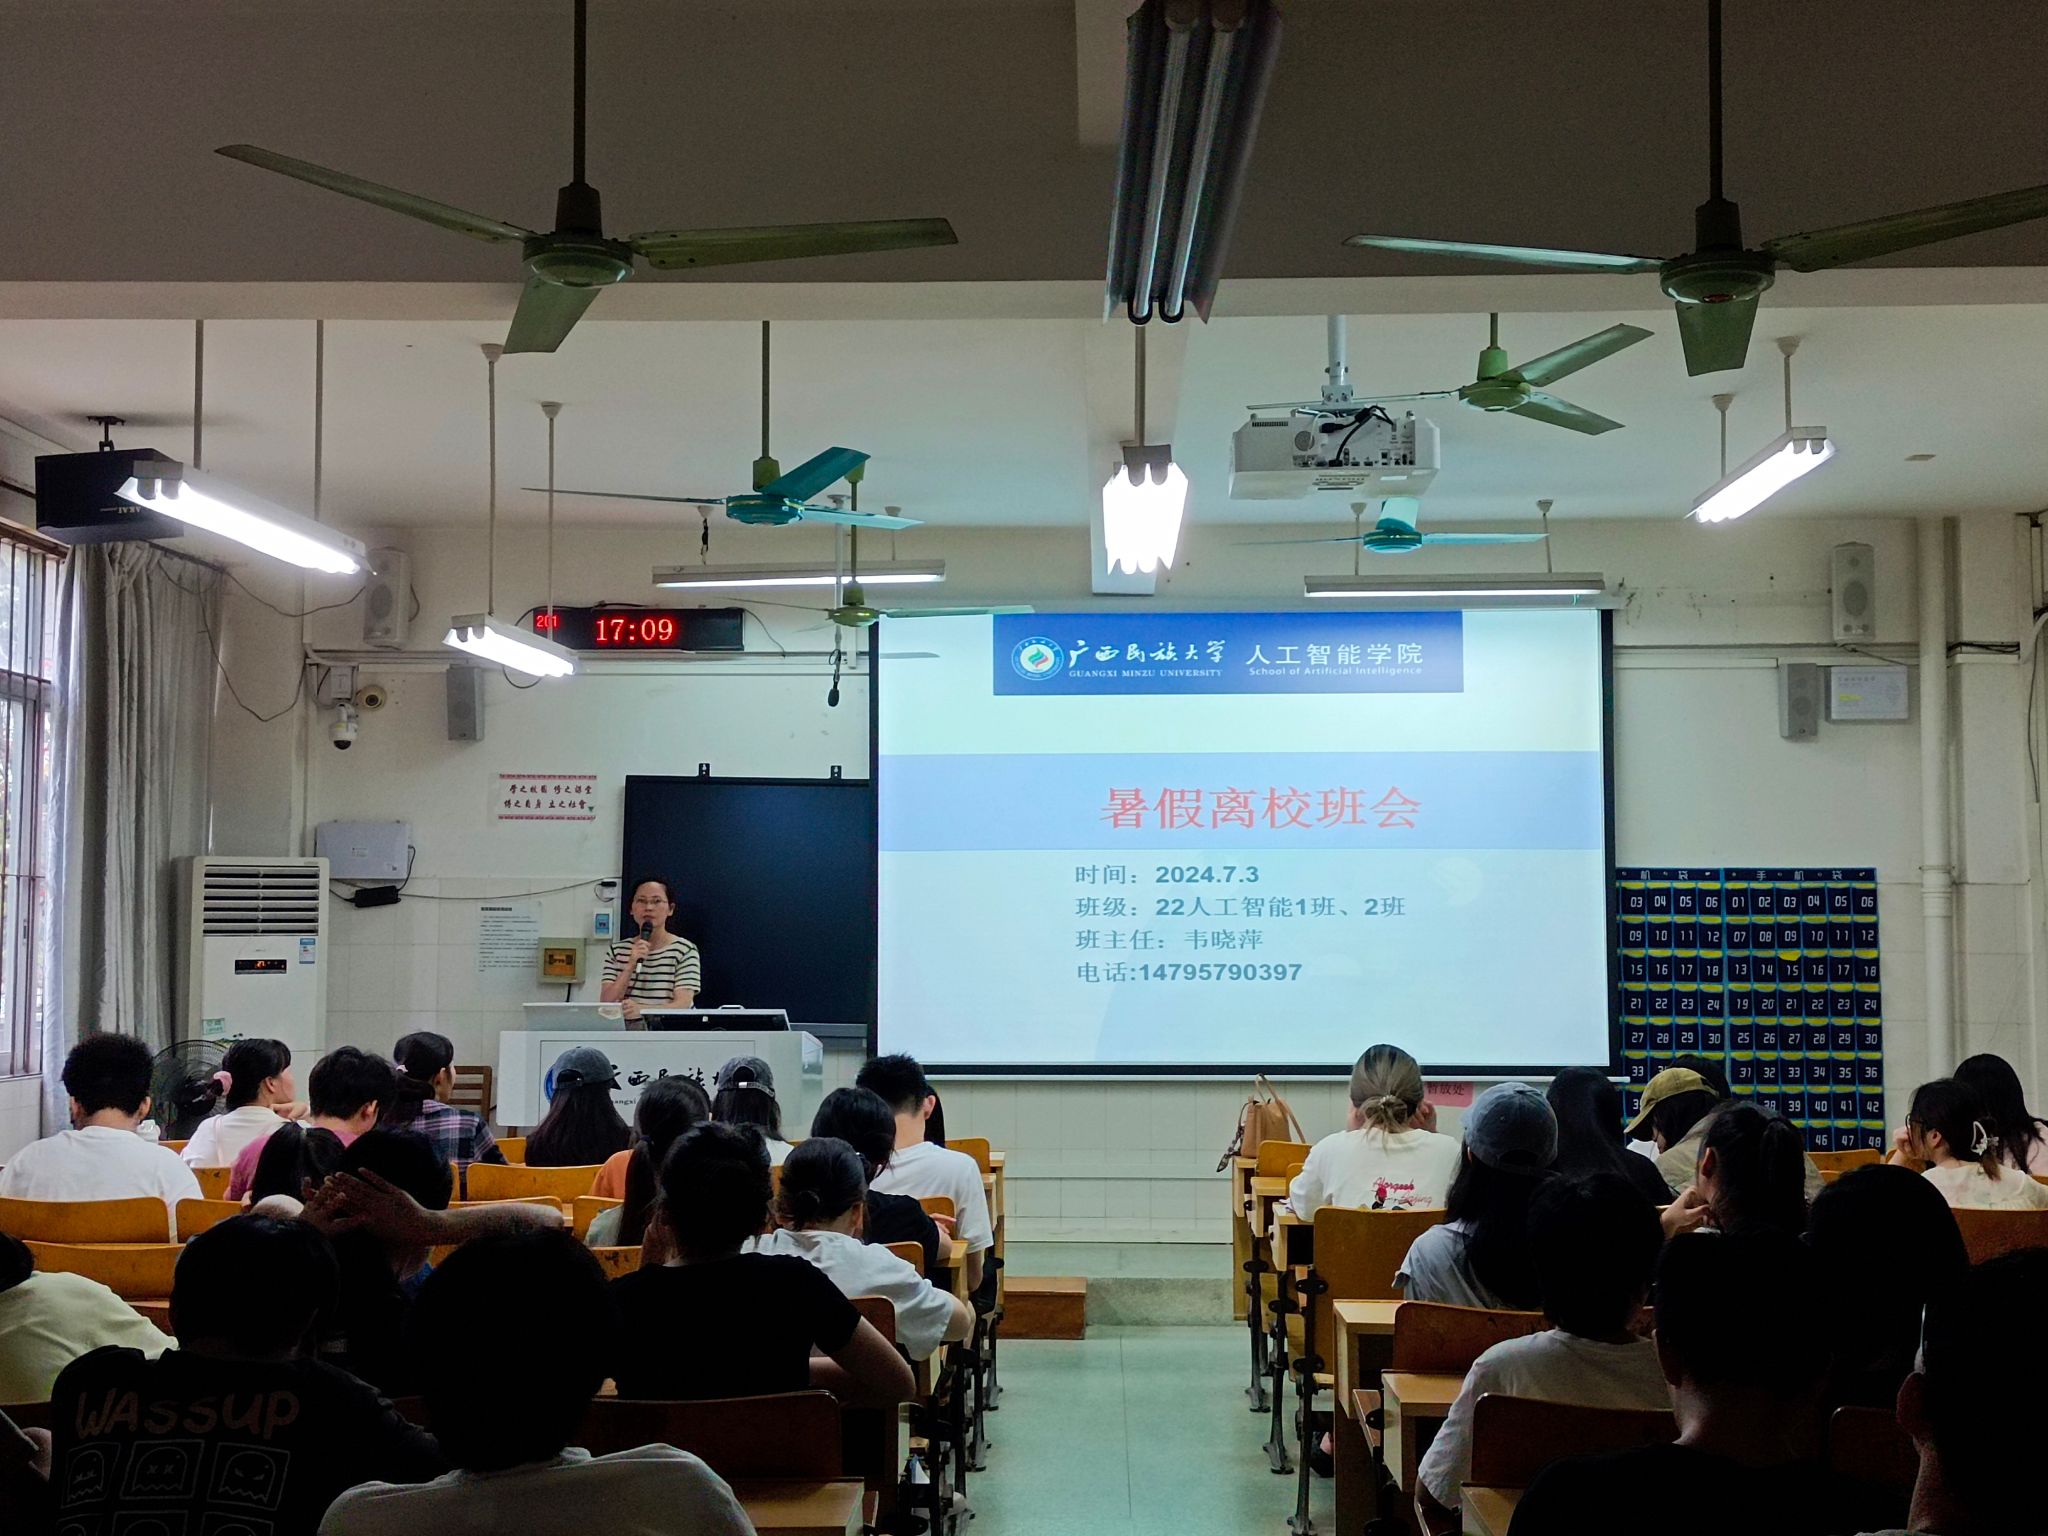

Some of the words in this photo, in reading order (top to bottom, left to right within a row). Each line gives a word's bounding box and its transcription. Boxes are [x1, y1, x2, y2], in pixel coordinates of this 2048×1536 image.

[596, 618, 673, 641] 17:09
[1068, 639, 1226, 668] 广西民族大学
[1246, 643, 1423, 665] 人工智能学院
[1069, 669, 1118, 678] GUANGXI
[1122, 669, 1156, 677] MINZU
[1160, 669, 1223, 677] UNIVERSITY
[1249, 666, 1286, 676] School
[1289, 667, 1300, 676] of
[1304, 667, 1351, 676] Artificial
[1355, 666, 1422, 677] Intelligence
[1100, 785, 1423, 830] 暑假离校班会
[1630, 896, 1643, 908] 03
[1654, 895, 1667, 907] 04
[1679, 895, 1692, 908] 05
[1705, 896, 1718, 908] 06
[1732, 896, 1745, 908] 01
[1758, 896, 1771, 908] 02
[1783, 896, 1797, 908] 03
[1807, 895, 1820, 907] 04
[1834, 895, 1847, 907] 05
[1861, 896, 1874, 908] 06
[1629, 930, 1642, 941] 09
[1655, 930, 1668, 941] 10
[1681, 930, 1693, 941] 11
[1707, 931, 1720, 942] 12
[1733, 931, 1746, 942] 07
[1759, 931, 1772, 942] 08
[1784, 930, 1797, 942] 09
[1811, 930, 1824, 942] 10
[1836, 930, 1849, 941] 11
[1862, 930, 1875, 941] 12
[1631, 964, 1643, 975] 15
[1656, 963, 1668, 975] 16
[1681, 964, 1693, 975] 17
[1706, 965, 1719, 976] 18
[1735, 964, 1747, 975] 13
[1761, 964, 1773, 975] 14
[1786, 964, 1799, 976] 15
[1812, 964, 1824, 976] 16
[1838, 964, 1850, 975] 17
[1864, 965, 1877, 977] 18
[1630, 998, 1642, 1009] 21
[1655, 998, 1668, 1009] 22
[1681, 998, 1694, 1010] 23
[1707, 999, 1720, 1011] 24
[1737, 998, 1749, 1010] 19
[1761, 998, 1775, 1010] 20
[1786, 998, 1798, 1010] 21
[1811, 999, 1824, 1010] 22
[1837, 998, 1850, 1010] 23
[1864, 999, 1877, 1010] 24
[1631, 1031, 1644, 1043] 27
[1656, 1032, 1669, 1044] 28
[1681, 1031, 1694, 1043] 29
[1708, 1033, 1721, 1044] 30
[1737, 1032, 1750, 1044] 25
[1763, 1032, 1776, 1044] 26
[1788, 1033, 1801, 1044] 27
[1813, 1033, 1826, 1044] 28
[1838, 1033, 1851, 1044] 29
[1865, 1033, 1878, 1044] 30
[1631, 1065, 1644, 1077] 33
[1739, 1067, 1751, 1078] 31
[1763, 1067, 1776, 1078] 32
[1788, 1067, 1801, 1078] 33
[1813, 1066, 1826, 1078] 34
[1839, 1067, 1852, 1079] 35
[1865, 1066, 1878, 1078] 36
[1788, 1100, 1801, 1112] 39
[1814, 1100, 1828, 1112] 40
[1840, 1100, 1853, 1112] 41
[1867, 1100, 1880, 1112] 42
[1815, 1134, 1828, 1146] 46
[1841, 1135, 1854, 1146] 47
[1868, 1135, 1881, 1147] 48
